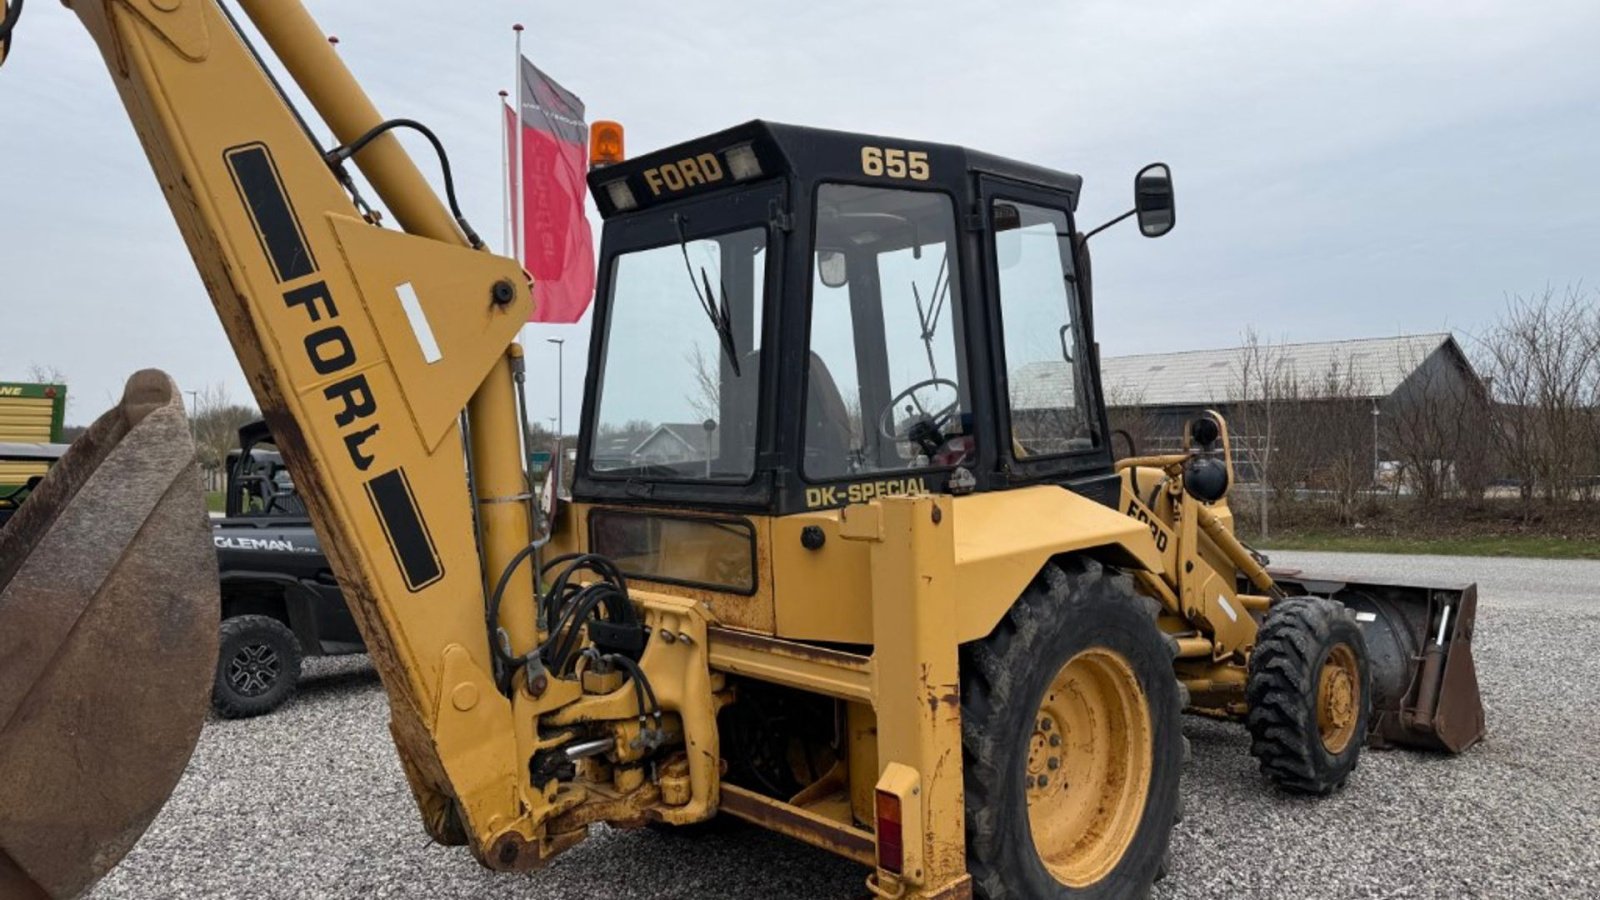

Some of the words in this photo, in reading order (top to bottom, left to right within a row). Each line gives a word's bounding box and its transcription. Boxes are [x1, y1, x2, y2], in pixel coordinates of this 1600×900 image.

[645, 153, 723, 196] FORD
[862, 147, 929, 181] 655
[806, 478, 929, 508] DK-SPECIAL
